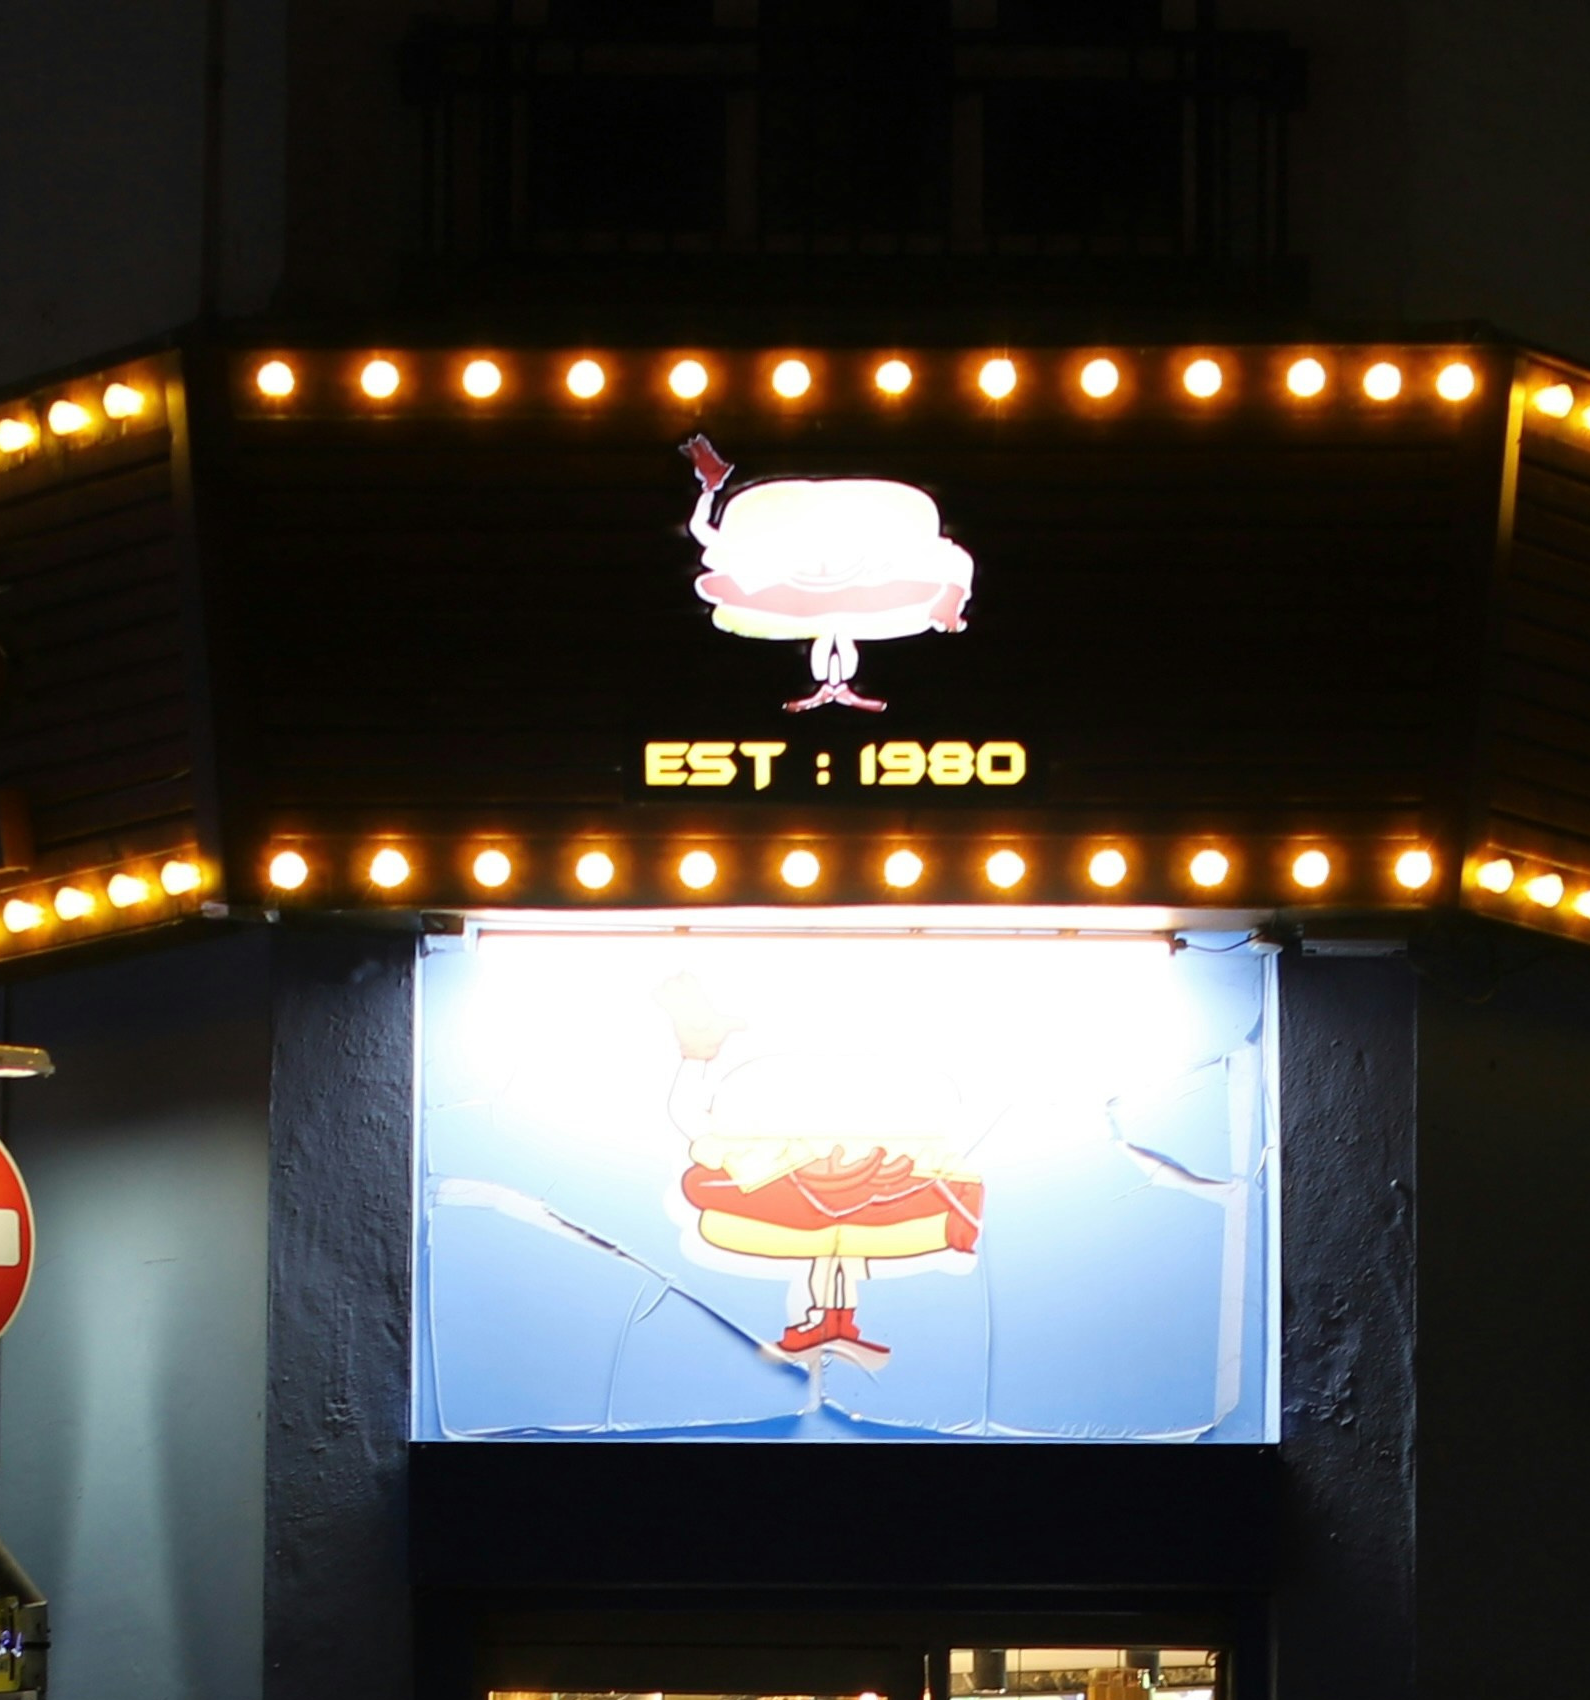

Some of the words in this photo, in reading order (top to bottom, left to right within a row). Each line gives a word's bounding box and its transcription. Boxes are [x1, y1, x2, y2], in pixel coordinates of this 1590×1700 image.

[644, 740, 787, 791] EST
[816, 752, 831, 786] :
[859, 740, 1027, 787] 1980
